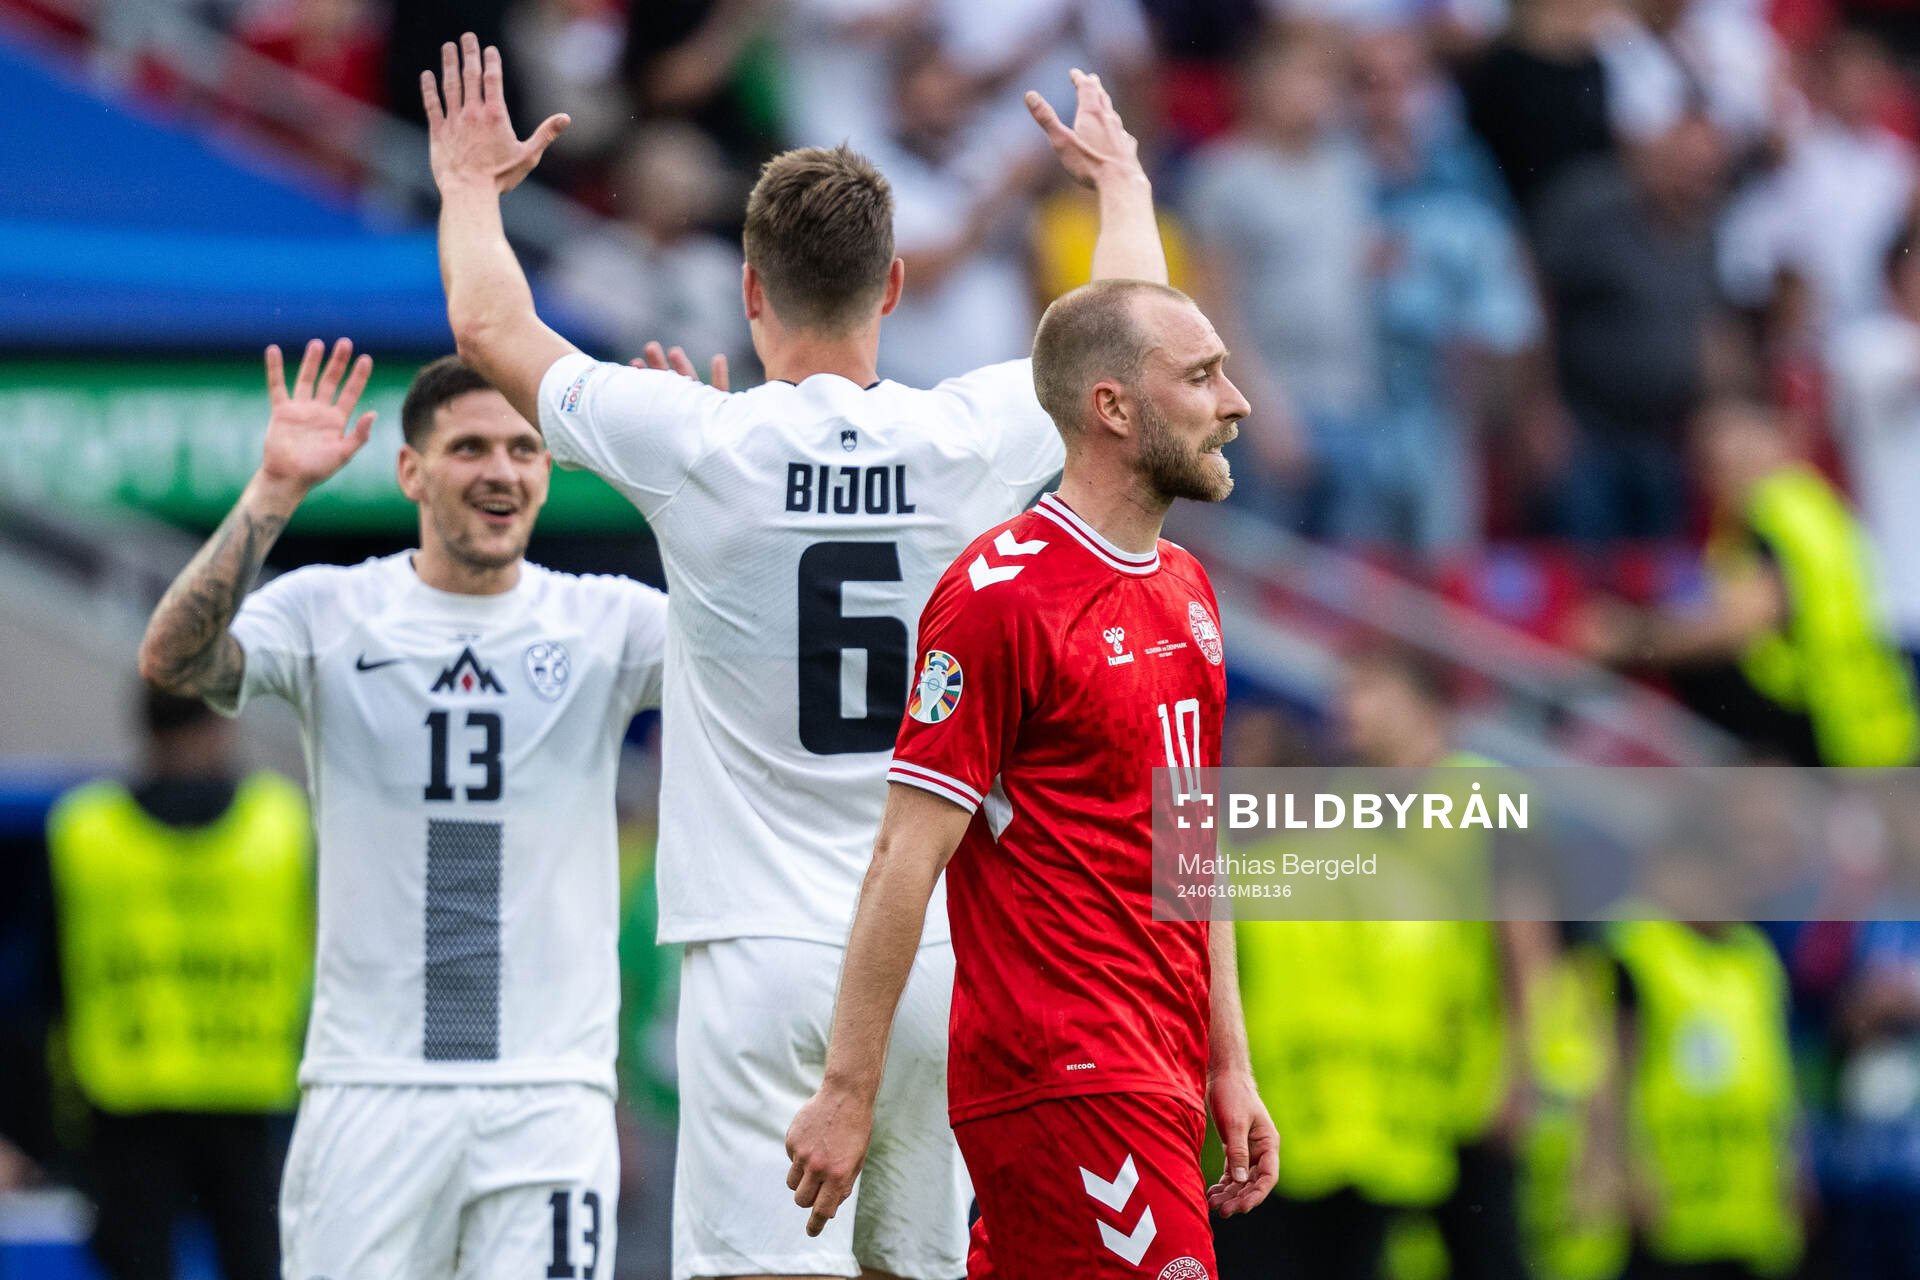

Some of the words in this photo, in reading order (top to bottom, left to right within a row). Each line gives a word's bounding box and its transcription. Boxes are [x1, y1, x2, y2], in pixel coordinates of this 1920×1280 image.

[785, 461, 916, 515] BIJOL
[797, 541, 909, 756] 6
[424, 710, 504, 802] 13
[1157, 698, 1202, 805] 10
[1066, 1062, 1096, 1071] BEECOOL
[547, 1191, 600, 1280] 13
